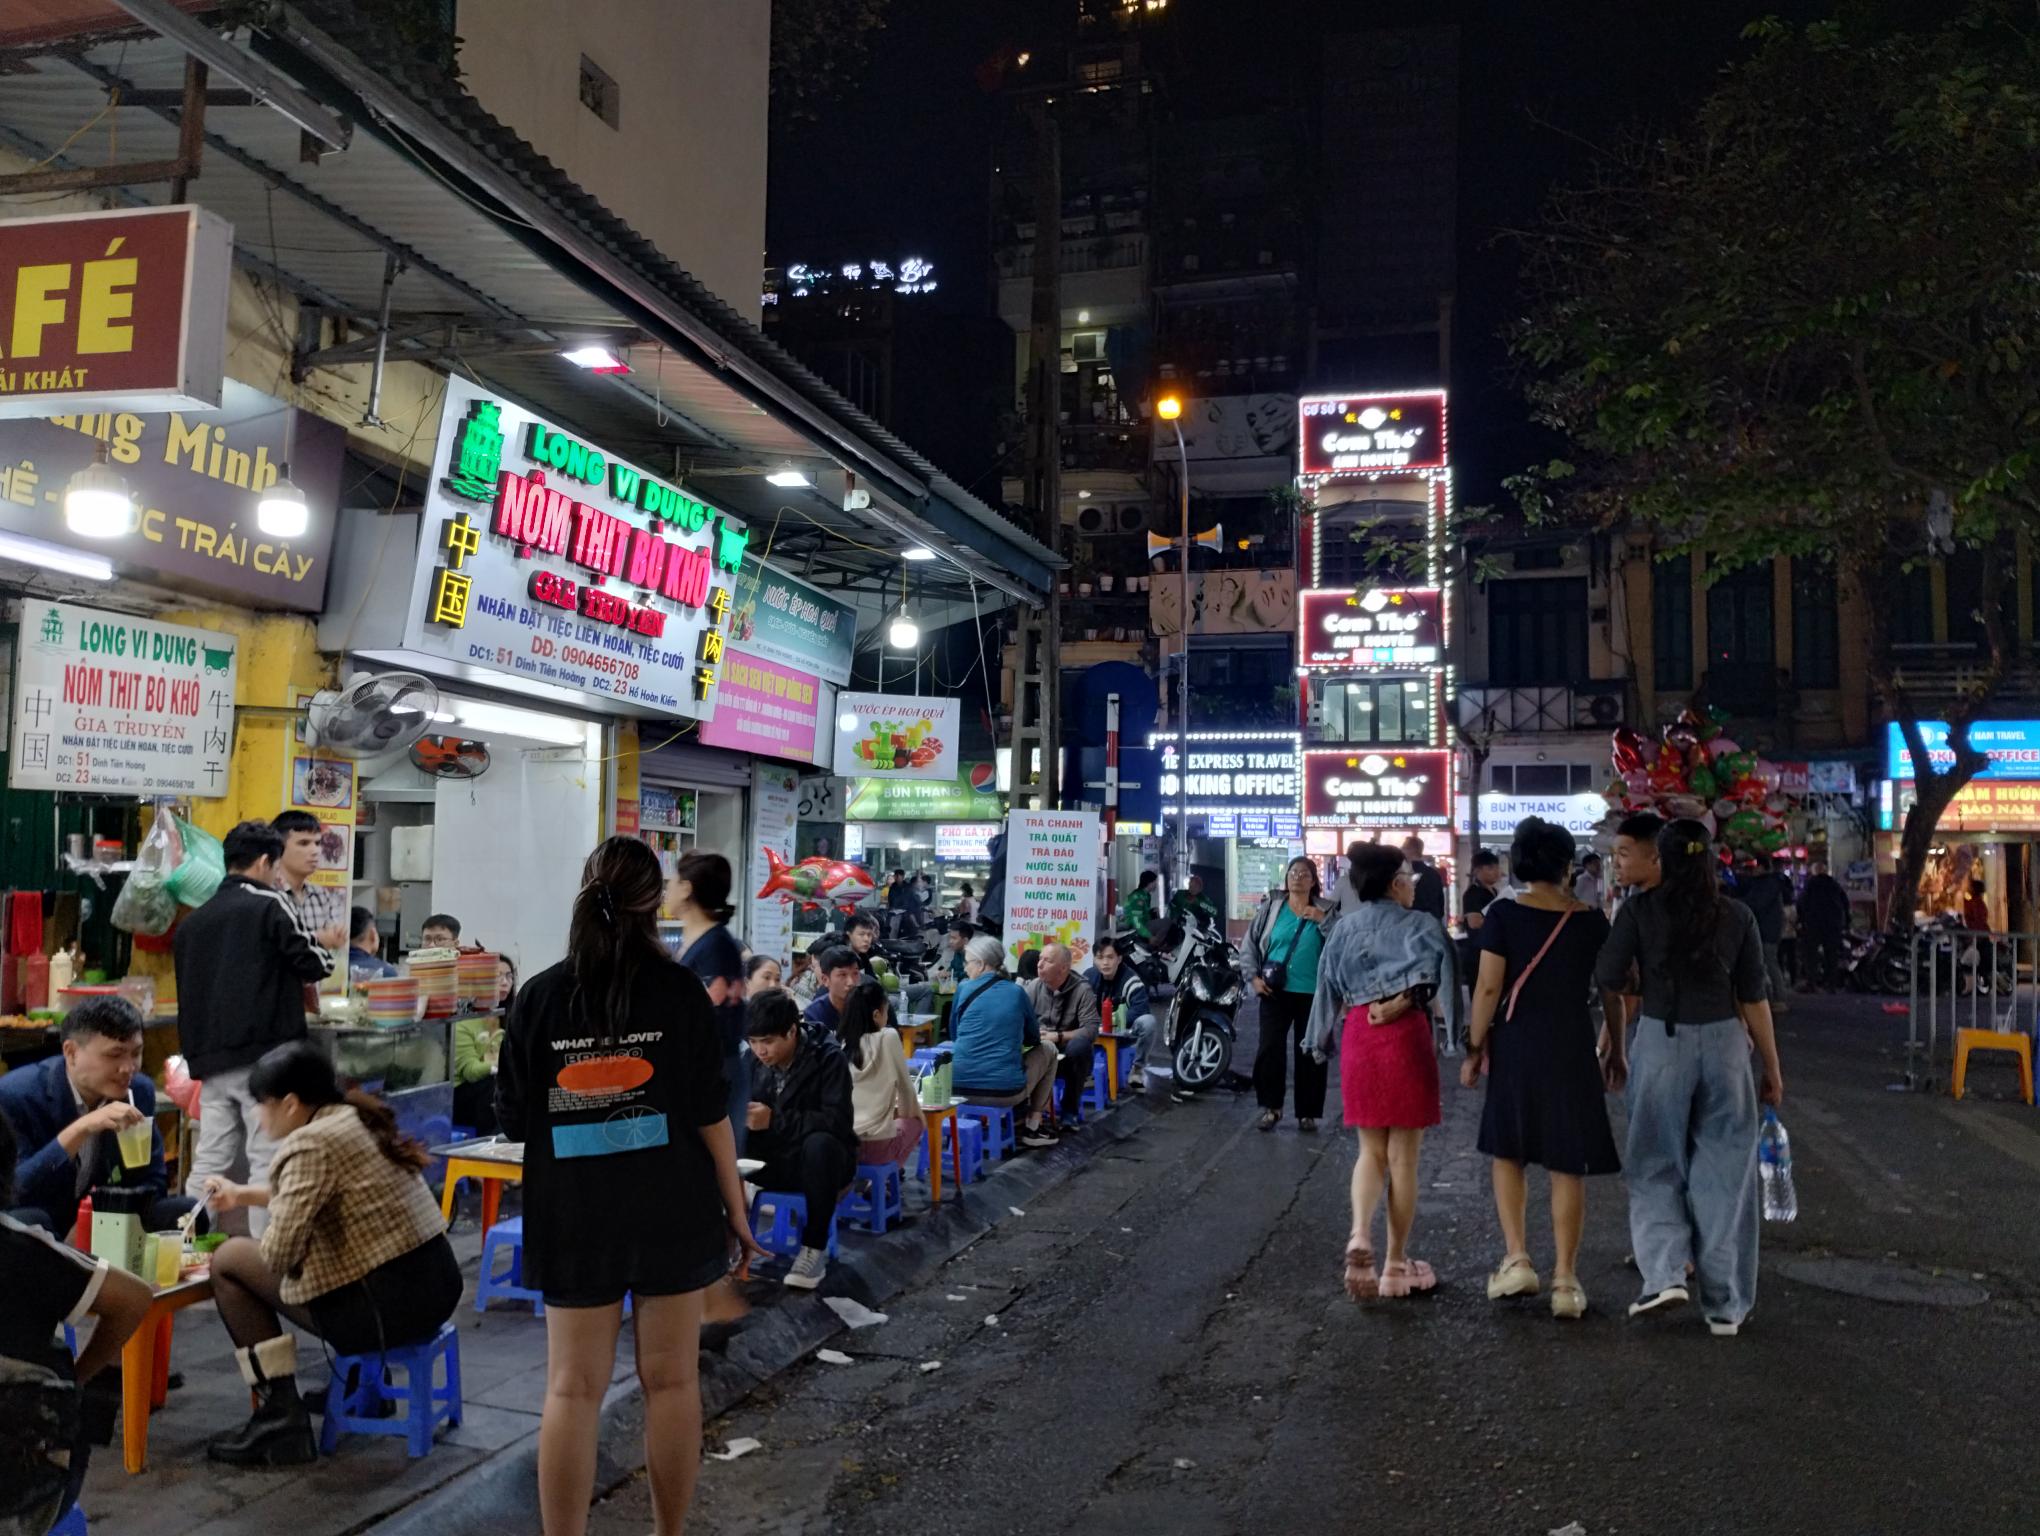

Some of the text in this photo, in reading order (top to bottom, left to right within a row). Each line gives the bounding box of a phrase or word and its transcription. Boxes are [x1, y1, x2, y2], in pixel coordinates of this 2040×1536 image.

[24, 366, 88, 390] KHÁT
[164, 412, 278, 493] Minh
[529, 422, 705, 532] LONG VI DUNG
[495, 469, 711, 609] NỘM THỊT BÒ KHÔ
[176, 522, 248, 566] TRÁI
[253, 541, 314, 582] CÂY
[432, 513, 481, 629] 中国
[530, 570, 577, 611] GIA
[477, 595, 517, 621] NHẬN
[519, 605, 543, 631] ĐẶT
[545, 612, 572, 639] TIỆC
[575, 626, 601, 646] LIÊN
[638, 641, 660, 665] TIỆC
[80, 621, 197, 667] LONG VI DUNG
[496, 647, 513, 666] 51
[613, 679, 628, 695] 23
[561, 645, 640, 680] 0904656708
[63, 657, 200, 719] NỘM THỊT BÒ KHÔ
[898, 706, 920, 717] HOA
[22, 689, 51, 770] 中国
[75, 717, 107, 733] GIA
[1996, 732, 2026, 740] TRAVEL
[203, 689, 231, 788] 牛肉干
[76, 752, 90, 767] 51
[1188, 753, 1295, 769] EXPRESS TRAVEL
[75, 769, 90, 784] 23
[1234, 774, 1295, 796] OFFICE
[915, 786, 962, 798] THANG
[1519, 802, 1567, 813] THANG
[1998, 804, 2035, 814] NAM
[1047, 819, 1083, 829] CHANH
[1026, 861, 1054, 872] NƯỚC
[1024, 890, 1053, 901] NƯỚC
[1011, 905, 1035, 919] NƯỚC
[1037, 906, 1049, 919] ÉP
[1051, 907, 1068, 920] HOA
[551, 1037, 595, 1050] WHAT
[618, 1032, 663, 1044] LOVE?
